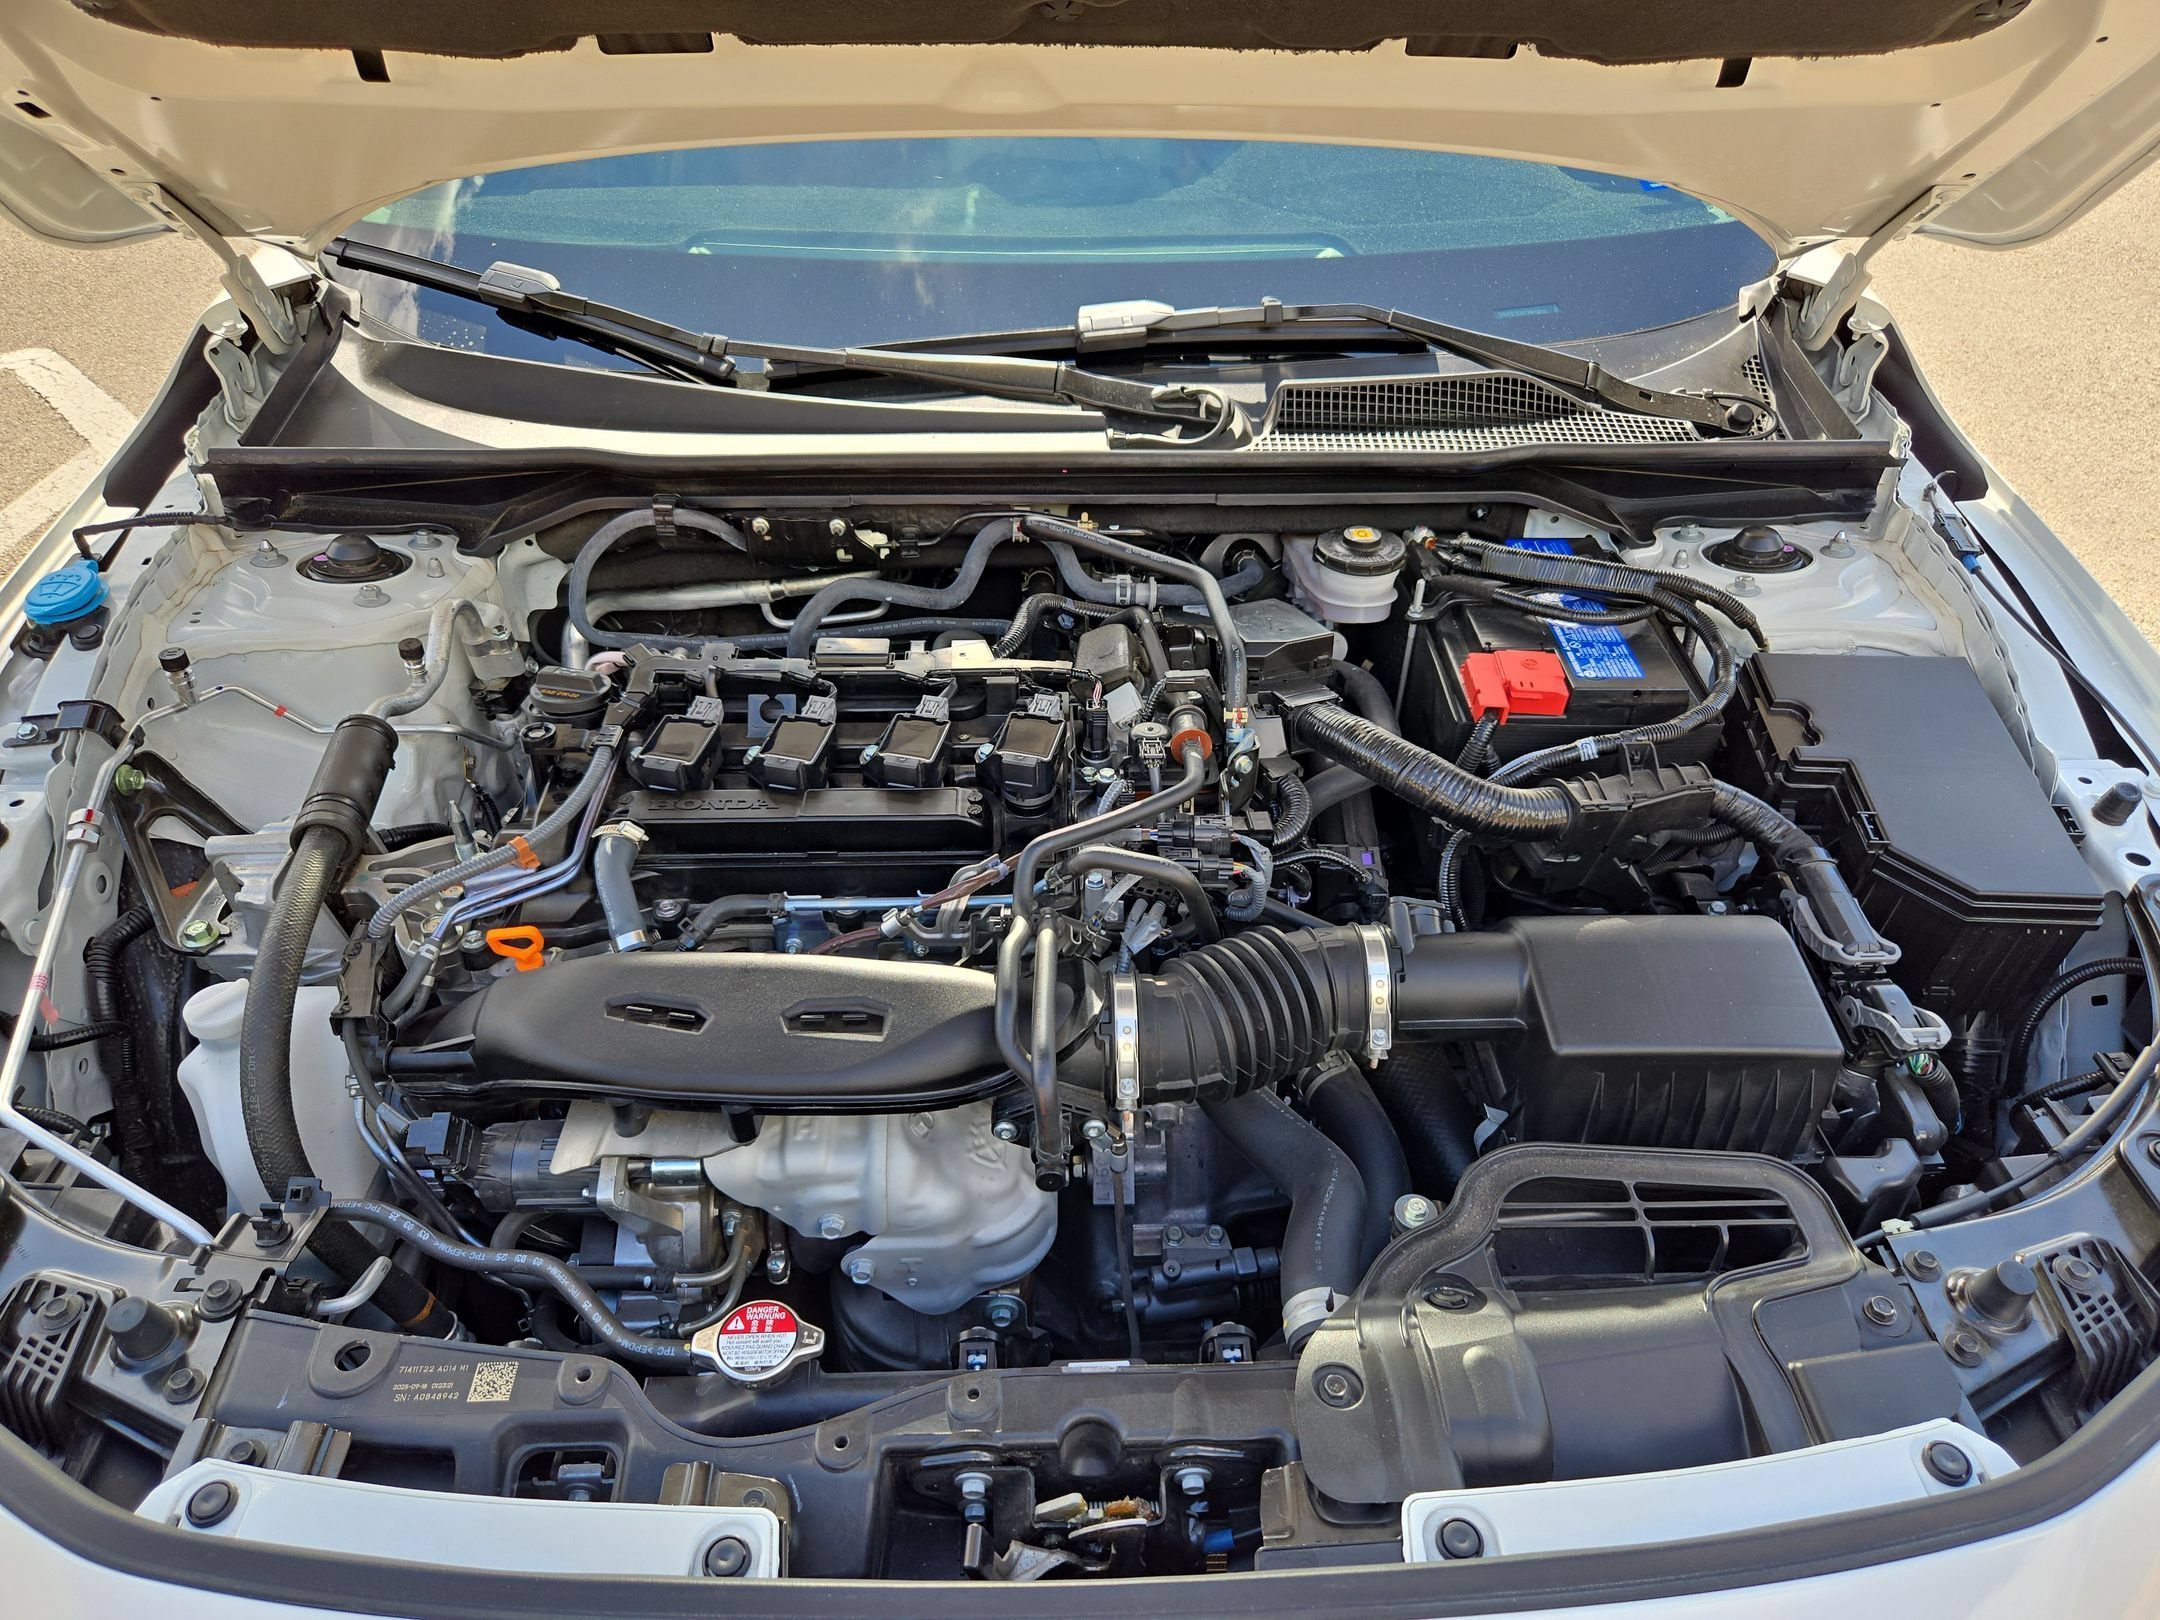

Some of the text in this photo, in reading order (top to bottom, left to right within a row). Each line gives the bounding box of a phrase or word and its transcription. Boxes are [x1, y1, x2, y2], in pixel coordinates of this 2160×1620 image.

[648, 799, 780, 811] HONDA
[364, 1203, 382, 1214] TPC
[388, 1211, 401, 1221] 25
[433, 1239, 466, 1257] >EPDM<
[469, 1252, 486, 1261] TPC
[746, 1306, 779, 1314] DANGER
[746, 1312, 786, 1321] WARNUNG
[656, 1347, 675, 1356] TPC
[394, 1393, 411, 1402] SN:
